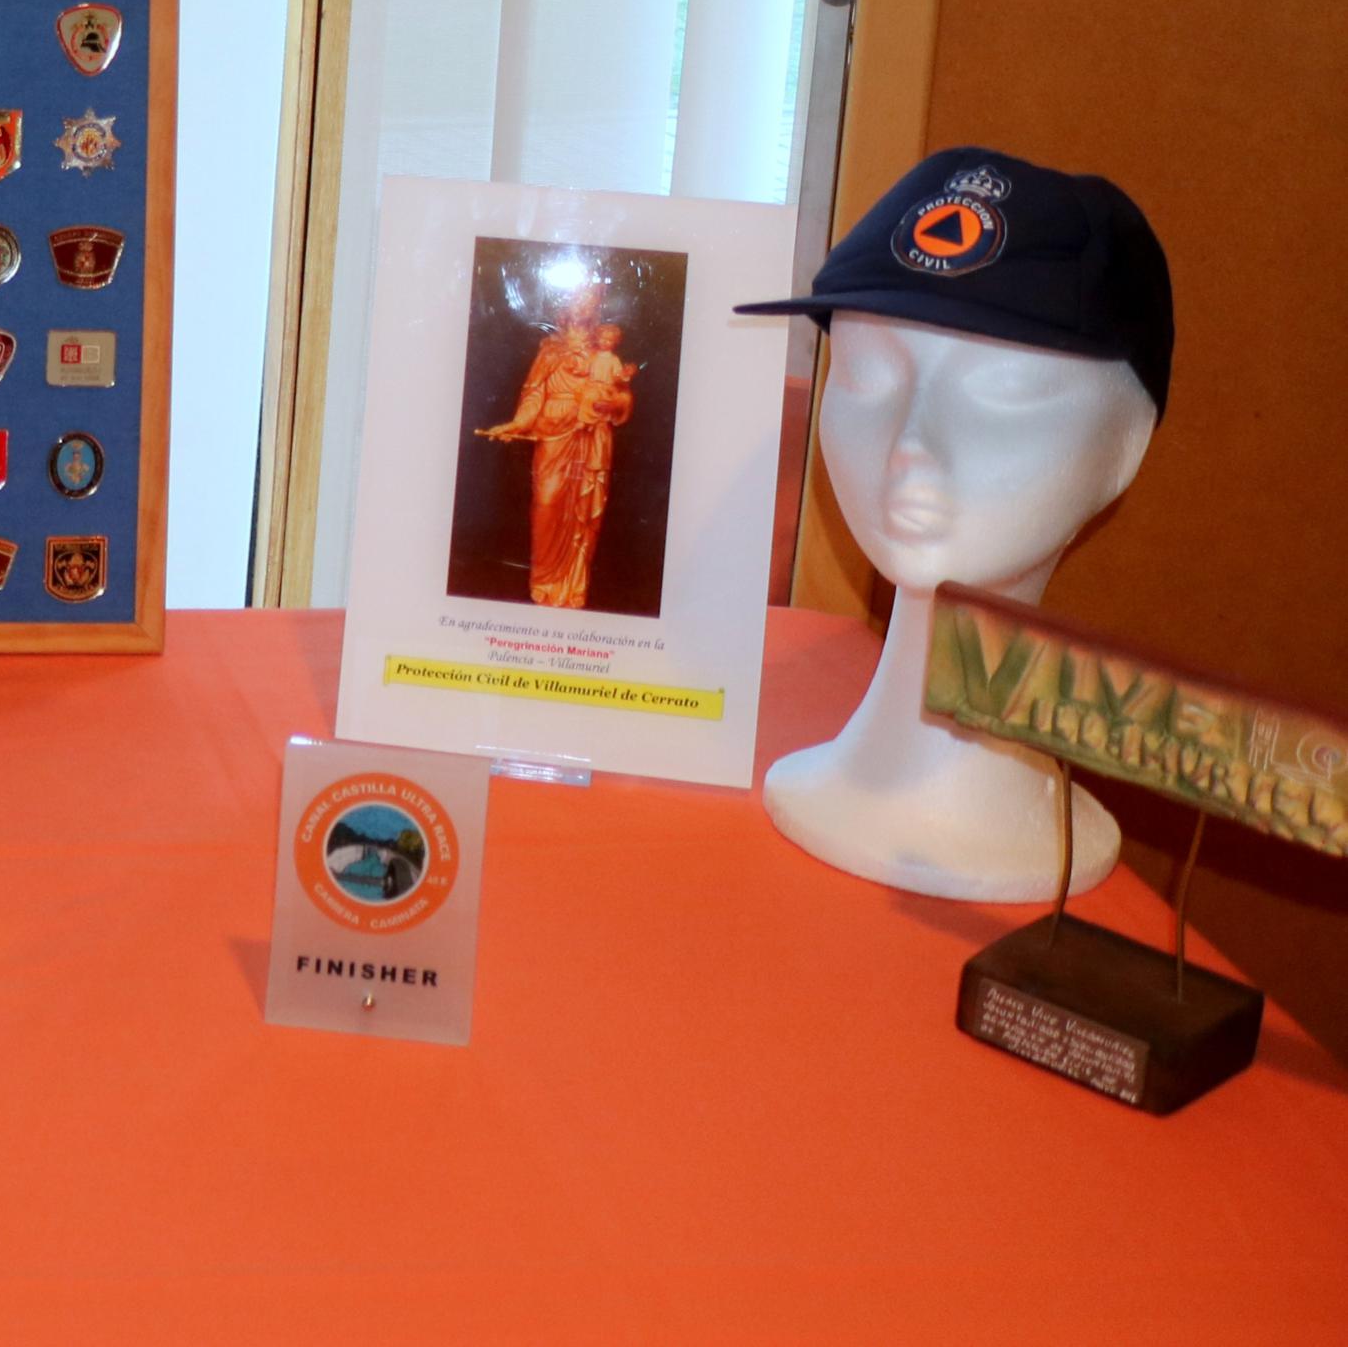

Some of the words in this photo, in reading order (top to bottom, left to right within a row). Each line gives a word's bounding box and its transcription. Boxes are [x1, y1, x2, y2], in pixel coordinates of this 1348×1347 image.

[917, 195, 995, 231] PROTECCION
[908, 248, 951, 270] CIVIL
[439, 616, 455, 627] En
[458, 619, 540, 637] agradecimiento
[552, 629, 564, 639] su
[567, 628, 636, 648] colaboración
[637, 639, 651, 649] en
[654, 639, 665, 651] la
[487, 651, 534, 666] Palencia
[548, 656, 611, 674] Villamuriel
[396, 662, 472, 683] Protección
[476, 672, 510, 688] Civil
[513, 675, 530, 689] de
[535, 679, 618, 700] Villamuriel
[621, 688, 638, 702] de
[641, 691, 700, 709] Cerrato
[302, 801, 330, 843] CANAL
[332, 783, 397, 801] CASTILLA
[401, 789, 438, 824] ULTRA
[433, 824, 452, 861] RACE
[370, 899, 429, 929] CAMINATA
[296, 955, 438, 987] FINISHER
